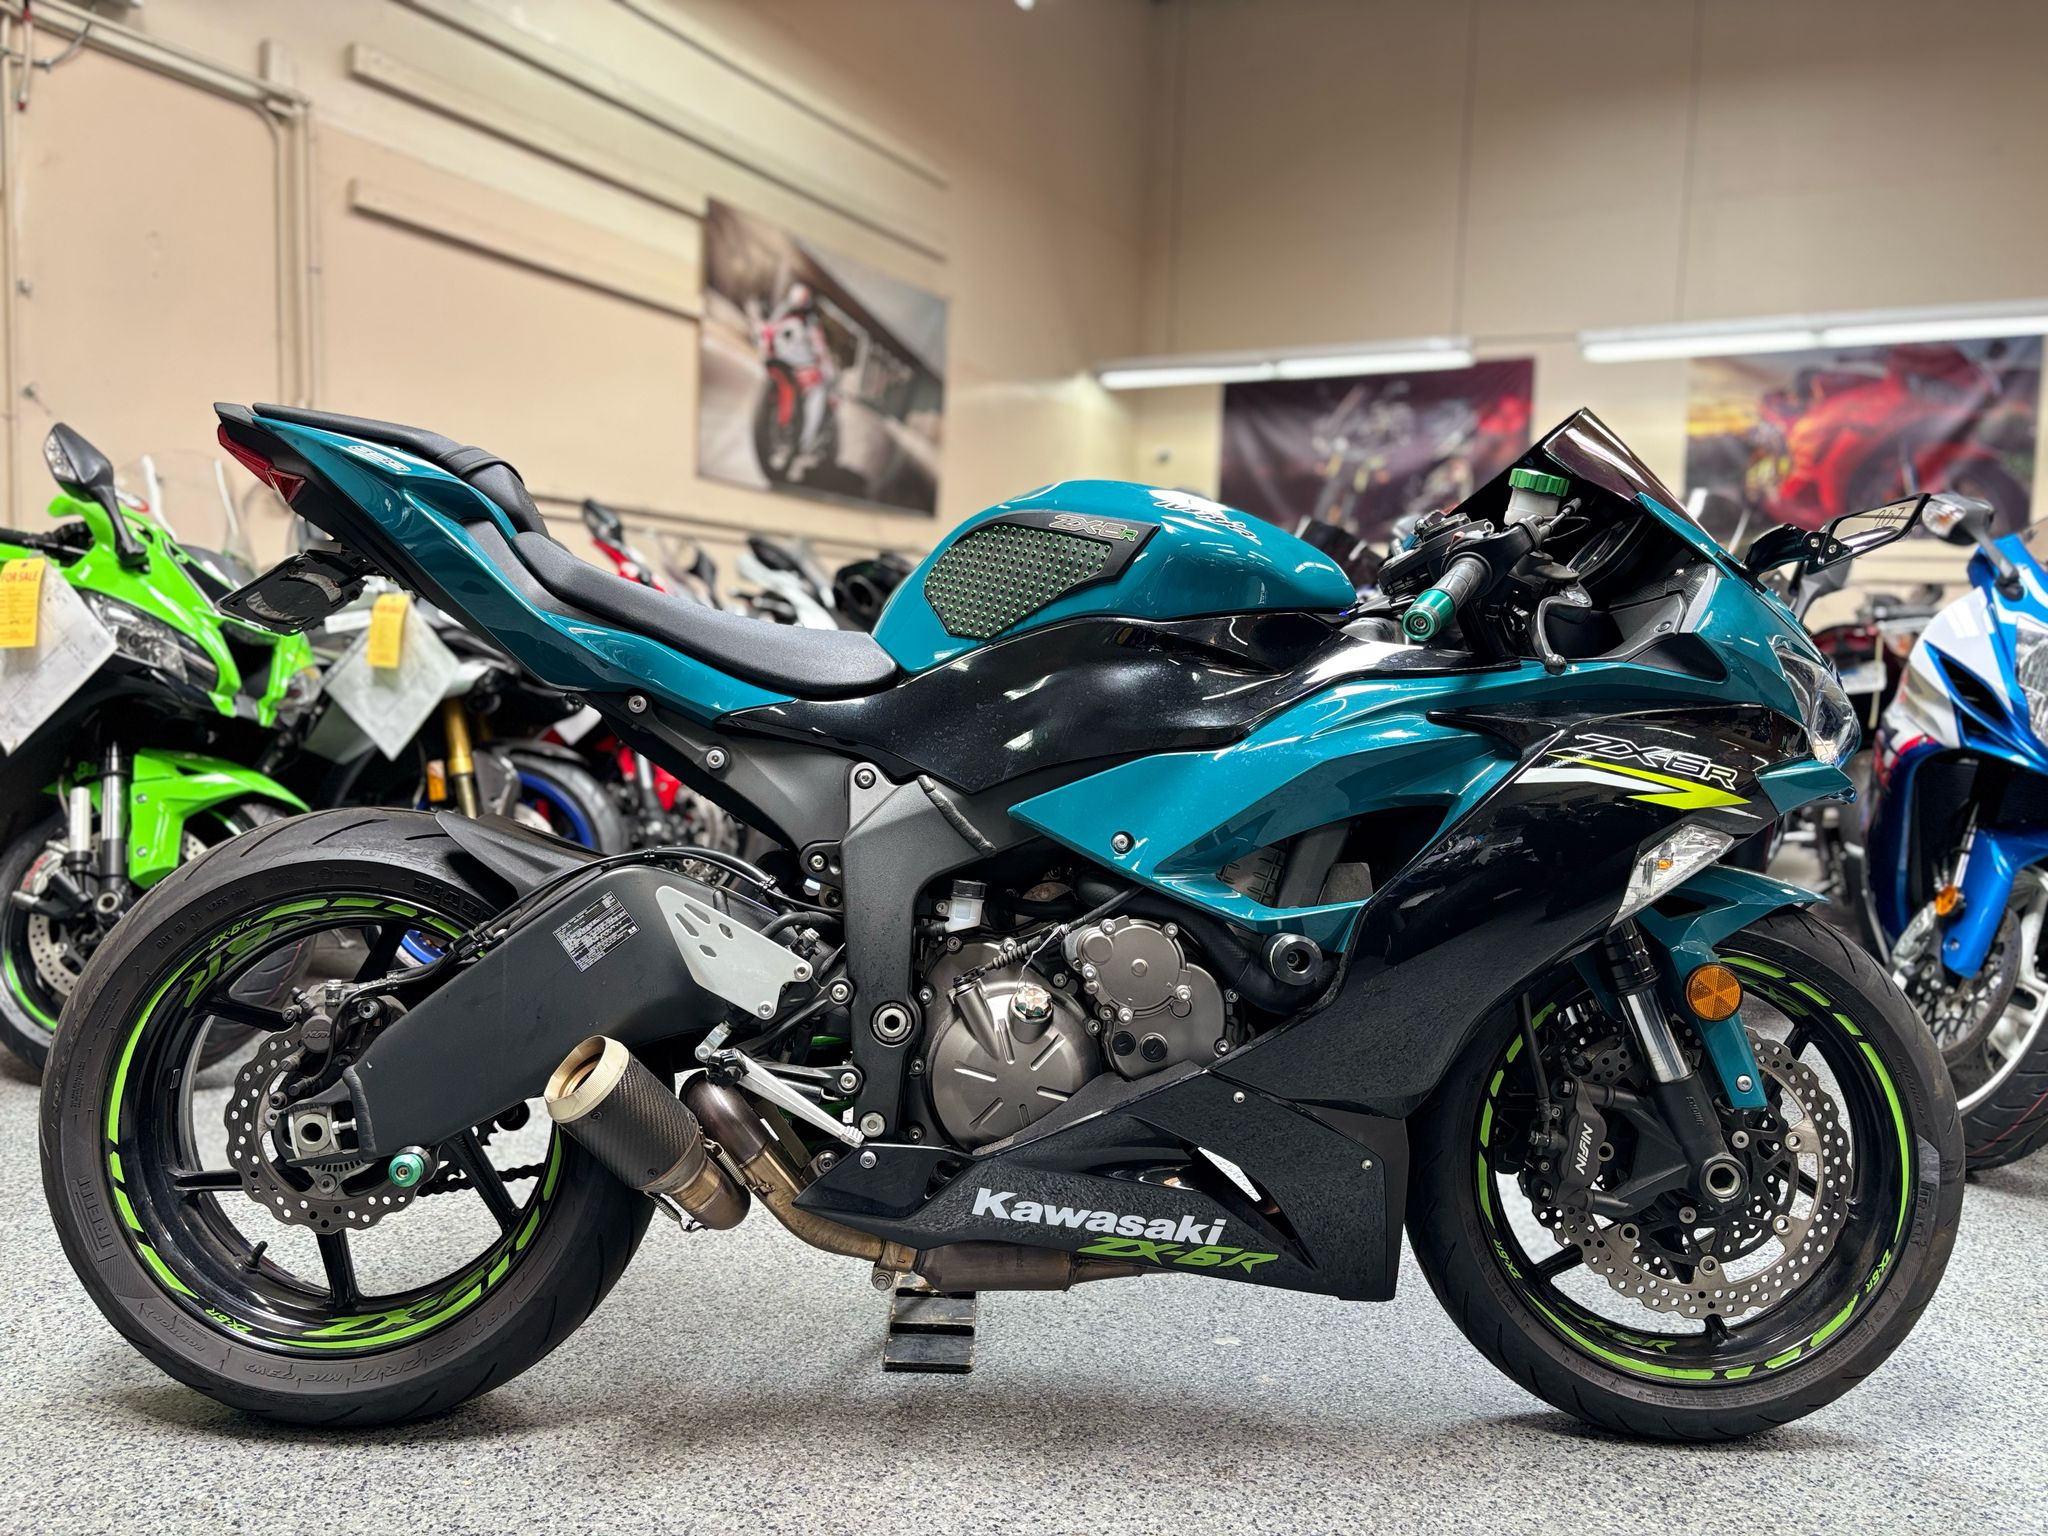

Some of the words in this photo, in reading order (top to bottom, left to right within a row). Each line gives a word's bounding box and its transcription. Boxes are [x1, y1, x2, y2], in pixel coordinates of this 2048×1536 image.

[1049, 513, 1138, 541] ZX-6R
[1567, 733, 1738, 790] ZX-6R
[209, 917, 252, 950] ZX-6R
[971, 1188, 1227, 1245] Kawasaki
[1077, 1236, 1279, 1275] ZX-6R
[1492, 1239, 1523, 1279] ZX-6R
[1865, 1249, 1893, 1292] ZX-6R
[205, 1307, 253, 1334] ZX-6R
